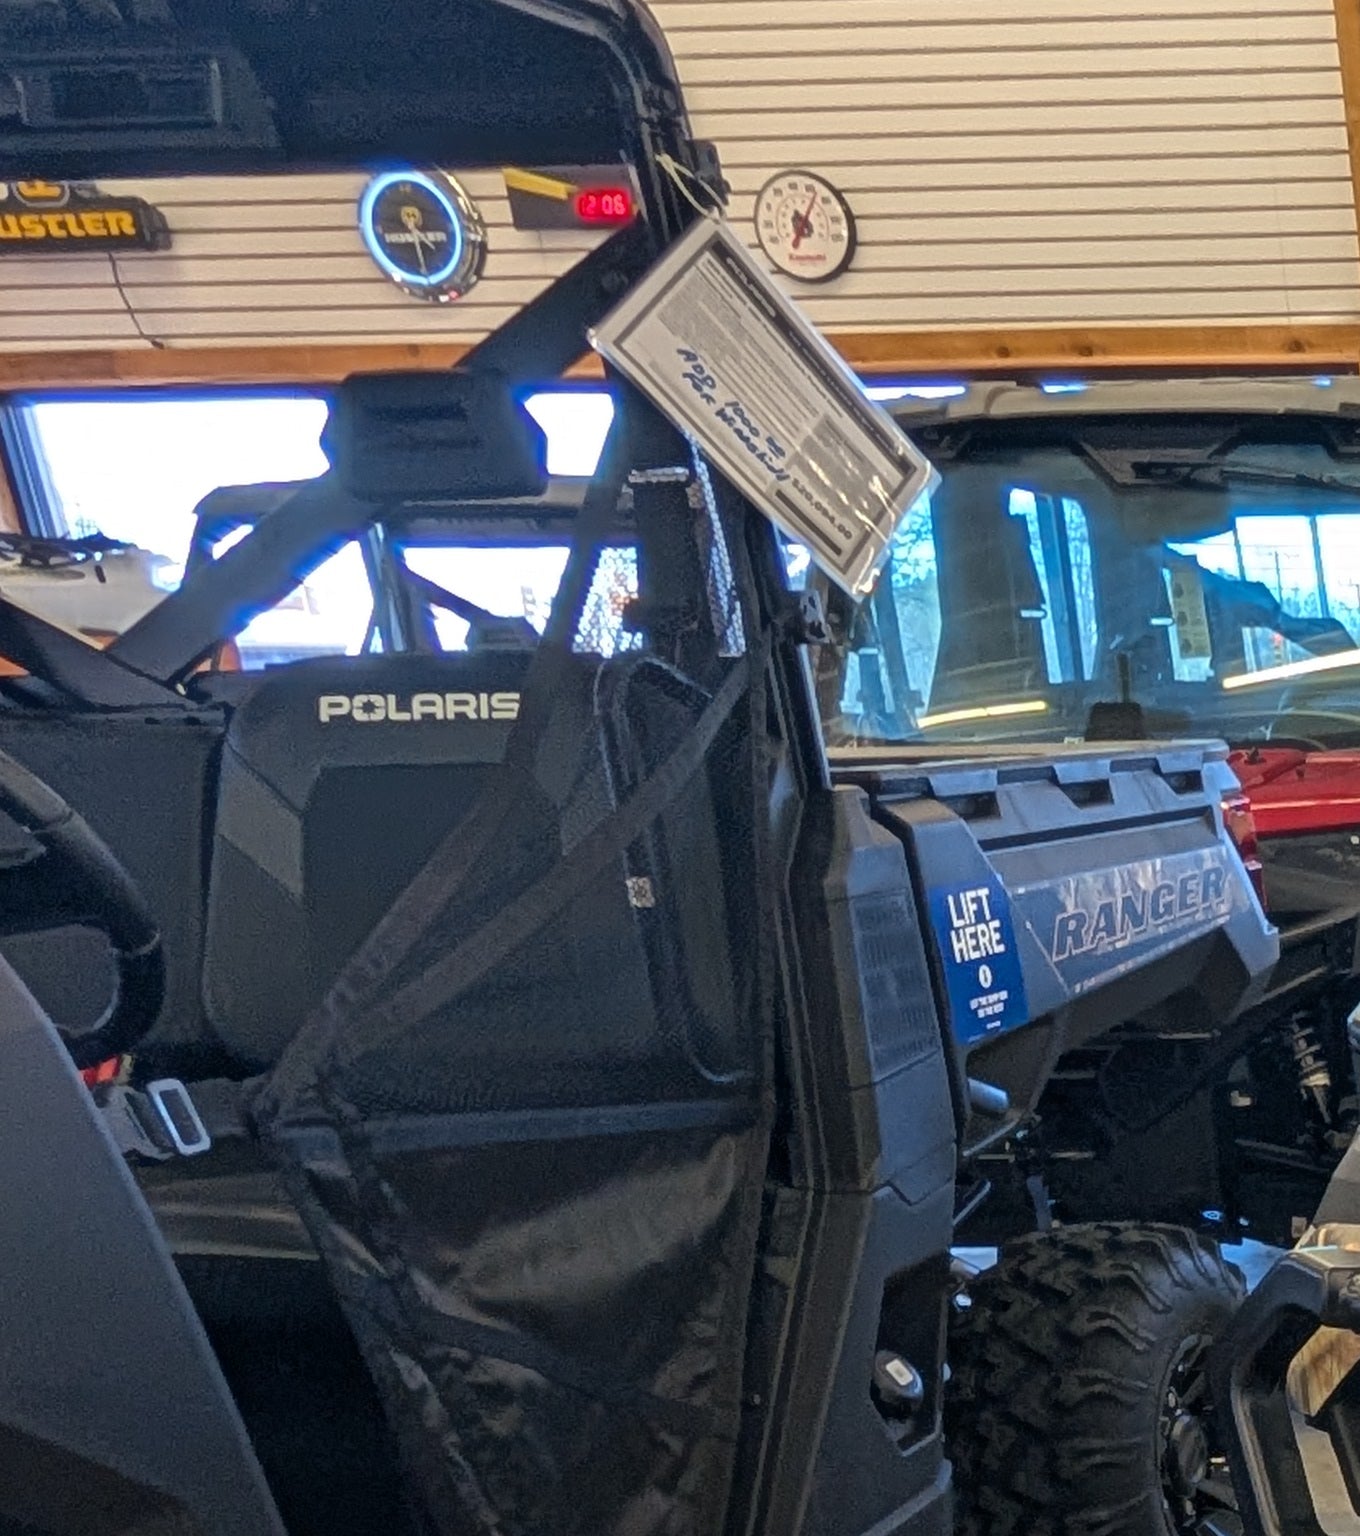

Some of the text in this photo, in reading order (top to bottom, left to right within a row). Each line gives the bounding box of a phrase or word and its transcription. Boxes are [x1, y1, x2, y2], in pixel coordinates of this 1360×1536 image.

[0, 209, 137, 240] USTLER
[319, 692, 521, 723] POLARIS
[947, 887, 991, 928] LIFT
[1052, 866, 1227, 962] RANGER
[950, 919, 1006, 964] HERE
